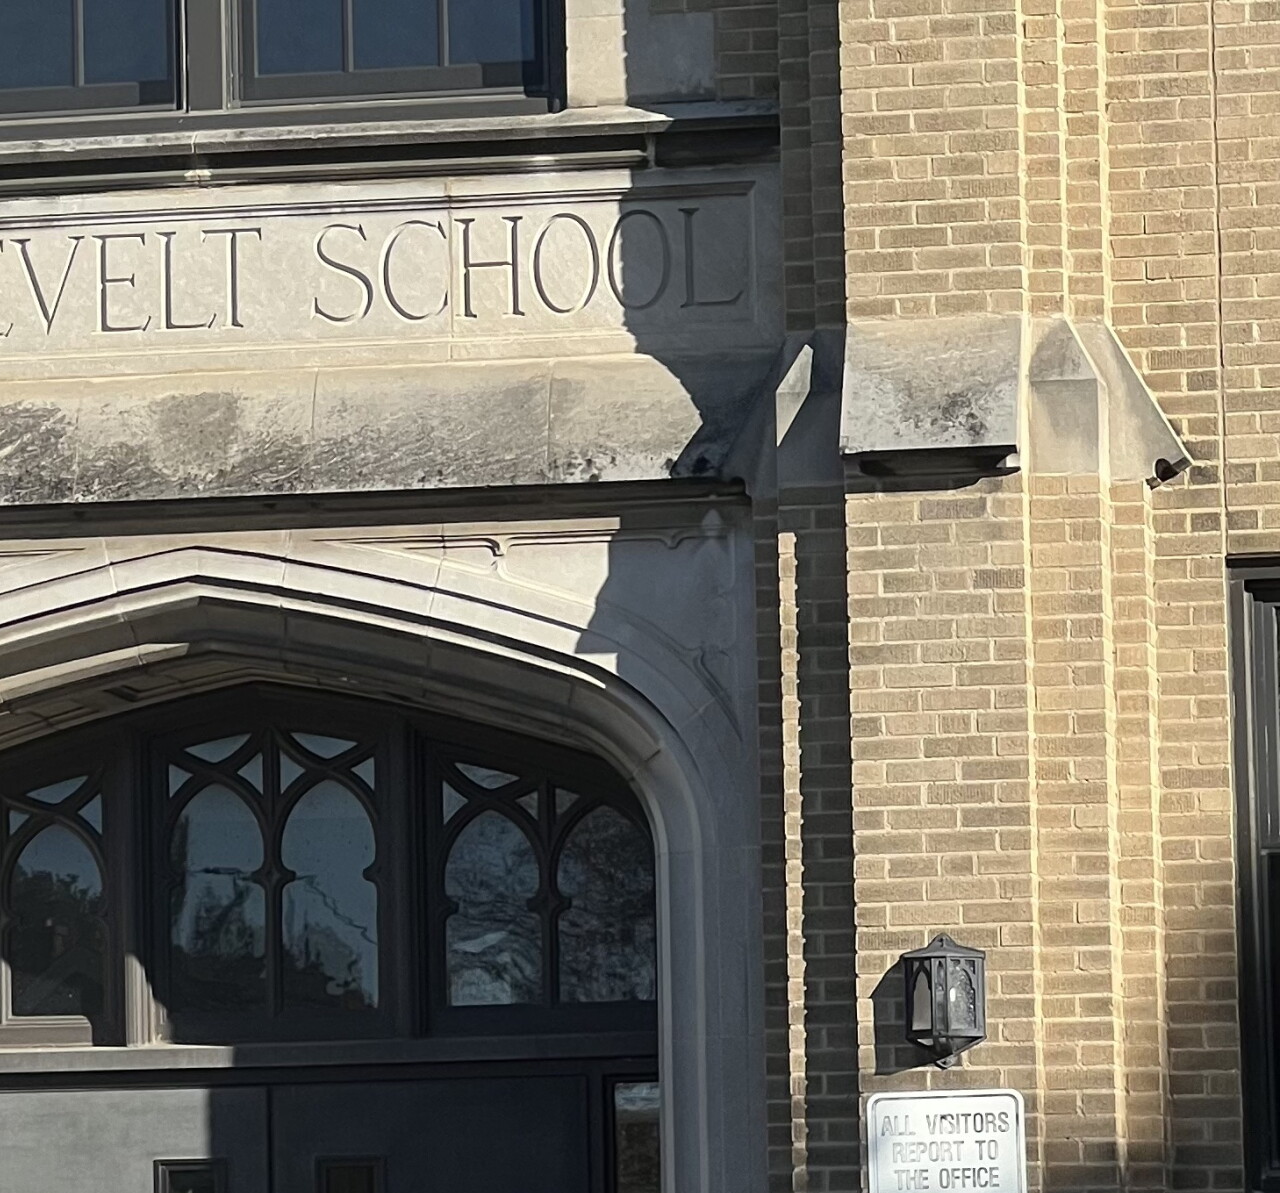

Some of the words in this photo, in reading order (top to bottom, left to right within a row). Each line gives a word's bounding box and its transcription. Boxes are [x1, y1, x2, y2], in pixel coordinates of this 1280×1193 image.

[312, 207, 744, 324] SCHOOL
[881, 1115, 916, 1137] ALL
[926, 1111, 1010, 1135] VISITORS
[892, 1141, 964, 1163] REPORT
[975, 1139, 999, 1161] TO
[894, 1169, 929, 1191] THE
[939, 1167, 1000, 1189] OFFICE
